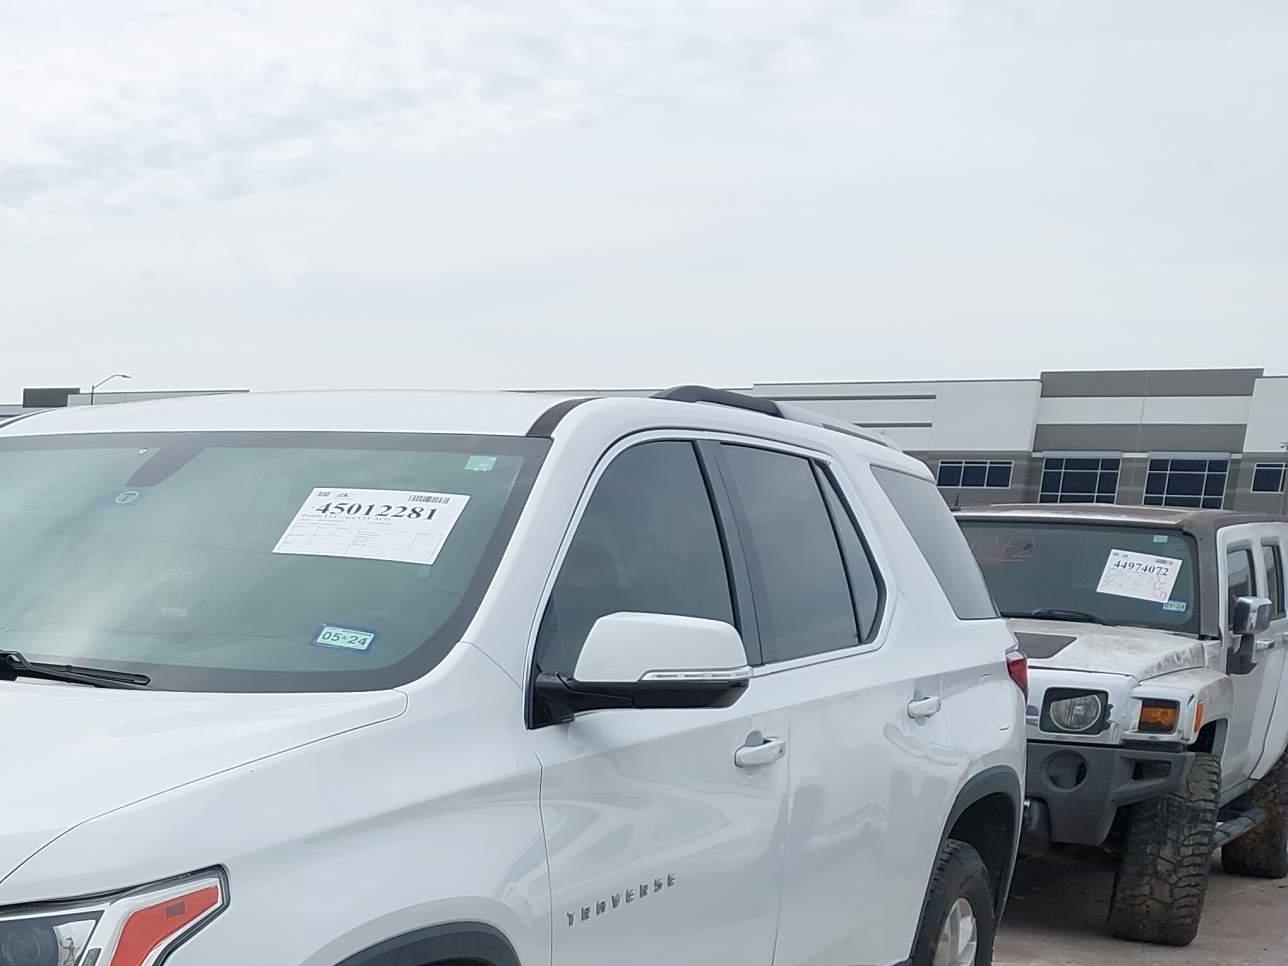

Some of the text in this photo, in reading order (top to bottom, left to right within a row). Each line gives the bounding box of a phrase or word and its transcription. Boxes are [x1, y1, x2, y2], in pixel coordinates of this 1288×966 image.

[315, 502, 439, 520] 45012281
[1113, 560, 1169, 576] 44974072
[322, 631, 368, 646] 05 24
[566, 873, 676, 927] TRAVERSE
